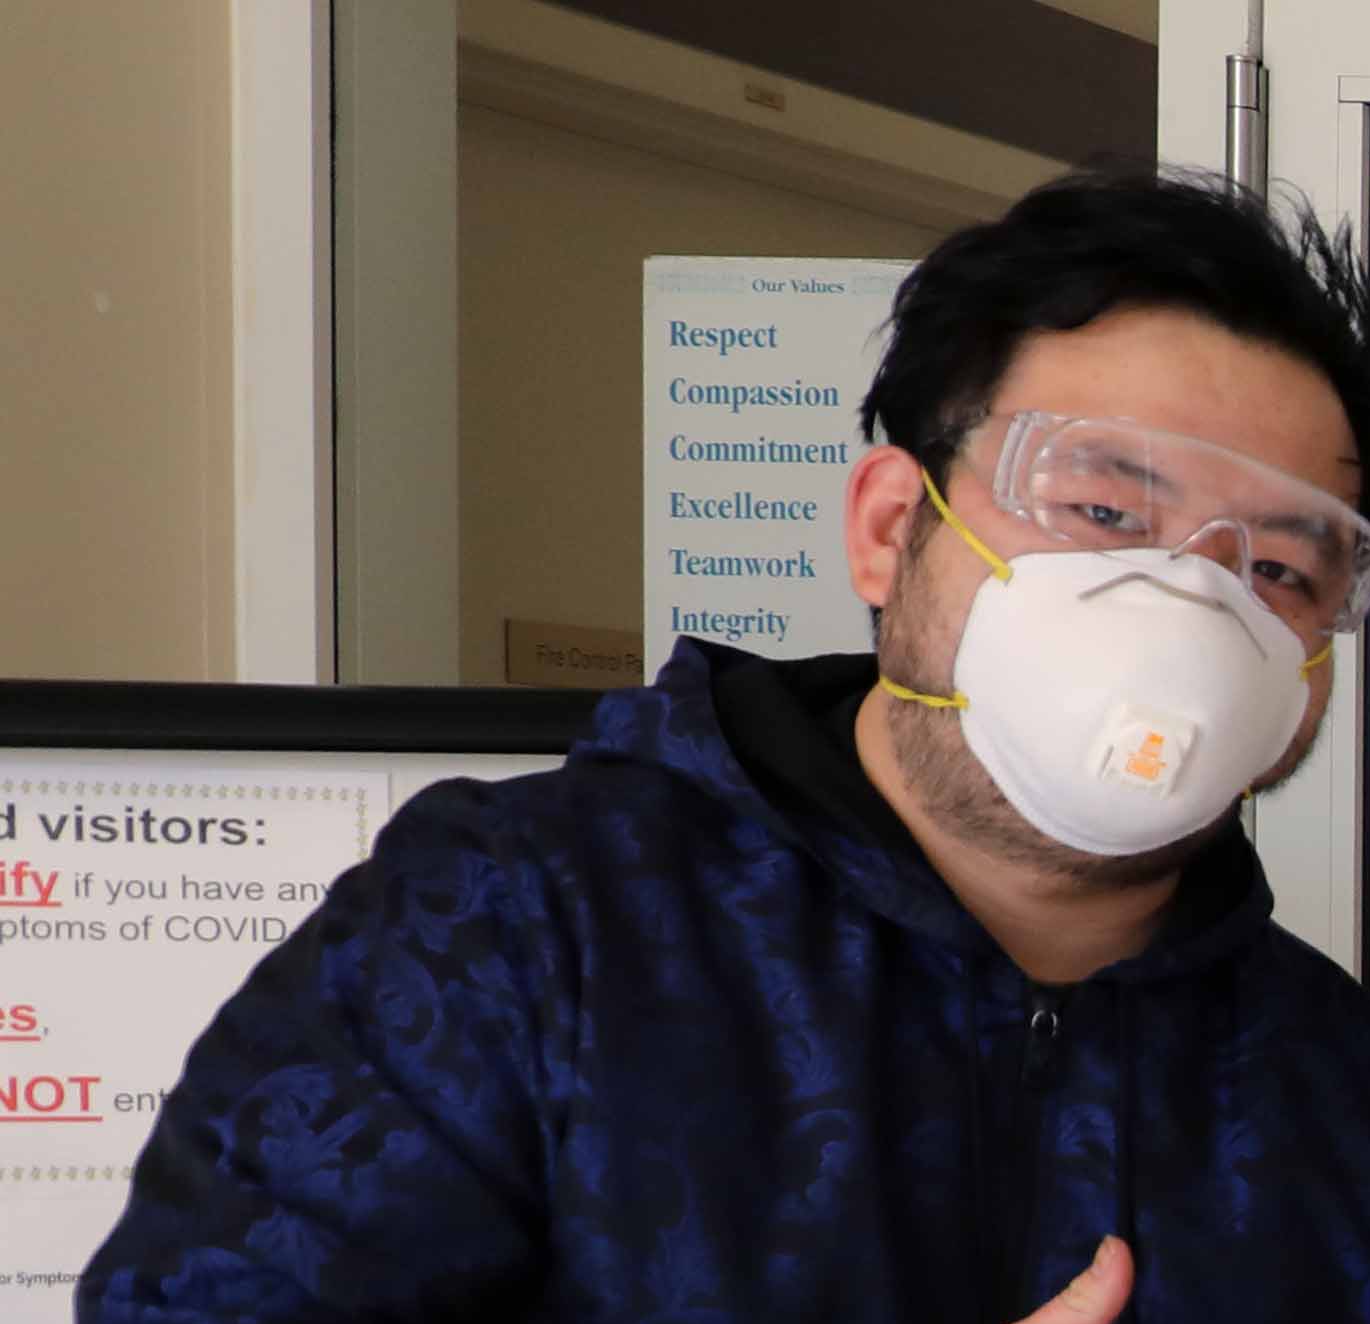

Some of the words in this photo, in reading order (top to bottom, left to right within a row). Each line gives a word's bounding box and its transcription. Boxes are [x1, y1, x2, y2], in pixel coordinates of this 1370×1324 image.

[752, 279, 785, 293] Our
[790, 279, 845, 294] Values
[669, 320, 777, 356] Respect
[669, 377, 839, 413] Compassion
[669, 435, 848, 465] Commitment
[669, 492, 817, 521] Excellence
[669, 549, 817, 578] Teamwork
[671, 606, 791, 641] Integrity
[39, 806, 267, 847] visitors:
[74, 872, 94, 898] if
[105, 877, 167, 904] you
[181, 874, 265, 901] have
[119, 915, 152, 942] of
[164, 914, 287, 943] COVID
[0, 1075, 102, 1113] NOT
